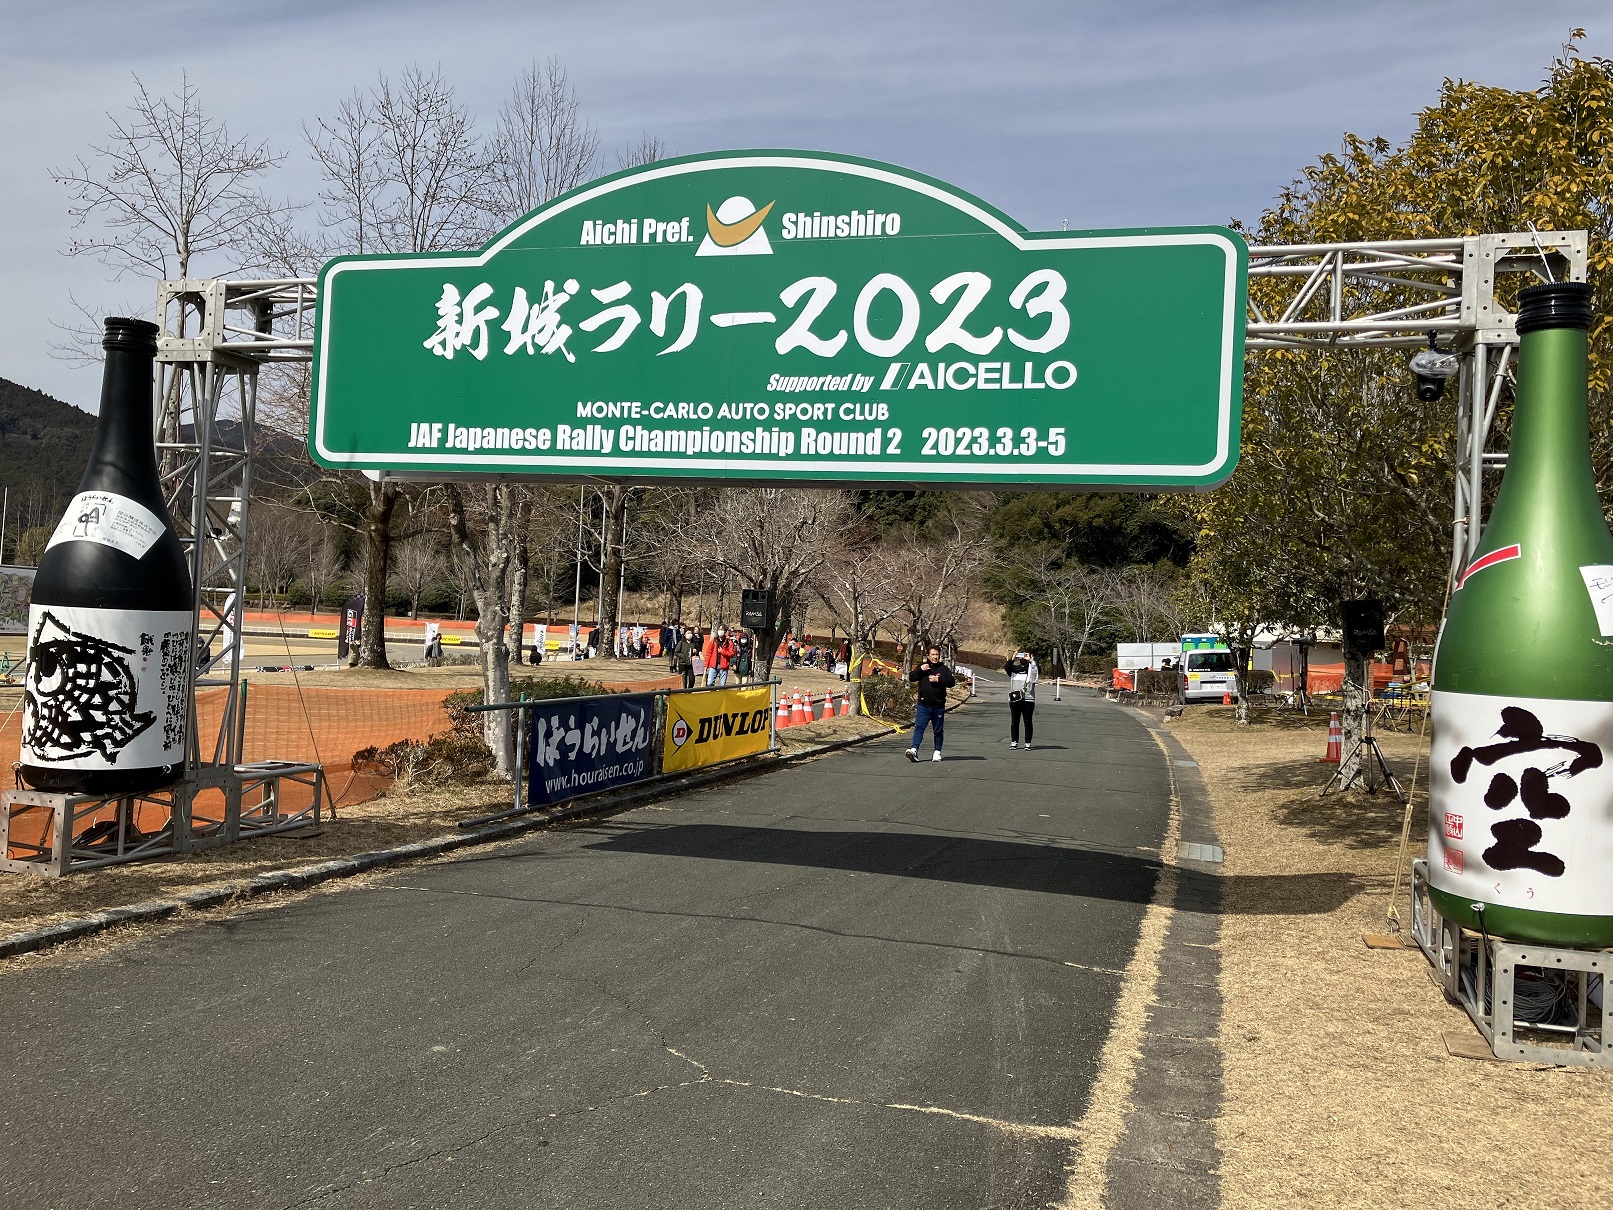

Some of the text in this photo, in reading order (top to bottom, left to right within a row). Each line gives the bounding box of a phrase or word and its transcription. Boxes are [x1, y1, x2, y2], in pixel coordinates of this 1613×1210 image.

[580, 216, 694, 245] Aichi Pref.
[782, 209, 901, 240] Shinshiro
[767, 360, 1078, 393] Supported by AICELLO
[576, 401, 889, 420] MONTE-CARLO AUTO SPORT CLUB
[408, 422, 1066, 457] JAF Japanese Rally Championship Round 2 2023.3.3-5
[537, 708, 650, 767] ほうらいせん
[694, 707, 769, 744] DUNLOP
[545, 757, 644, 793] www.houraisen.co.jp
[1450, 705, 1604, 877] 空
